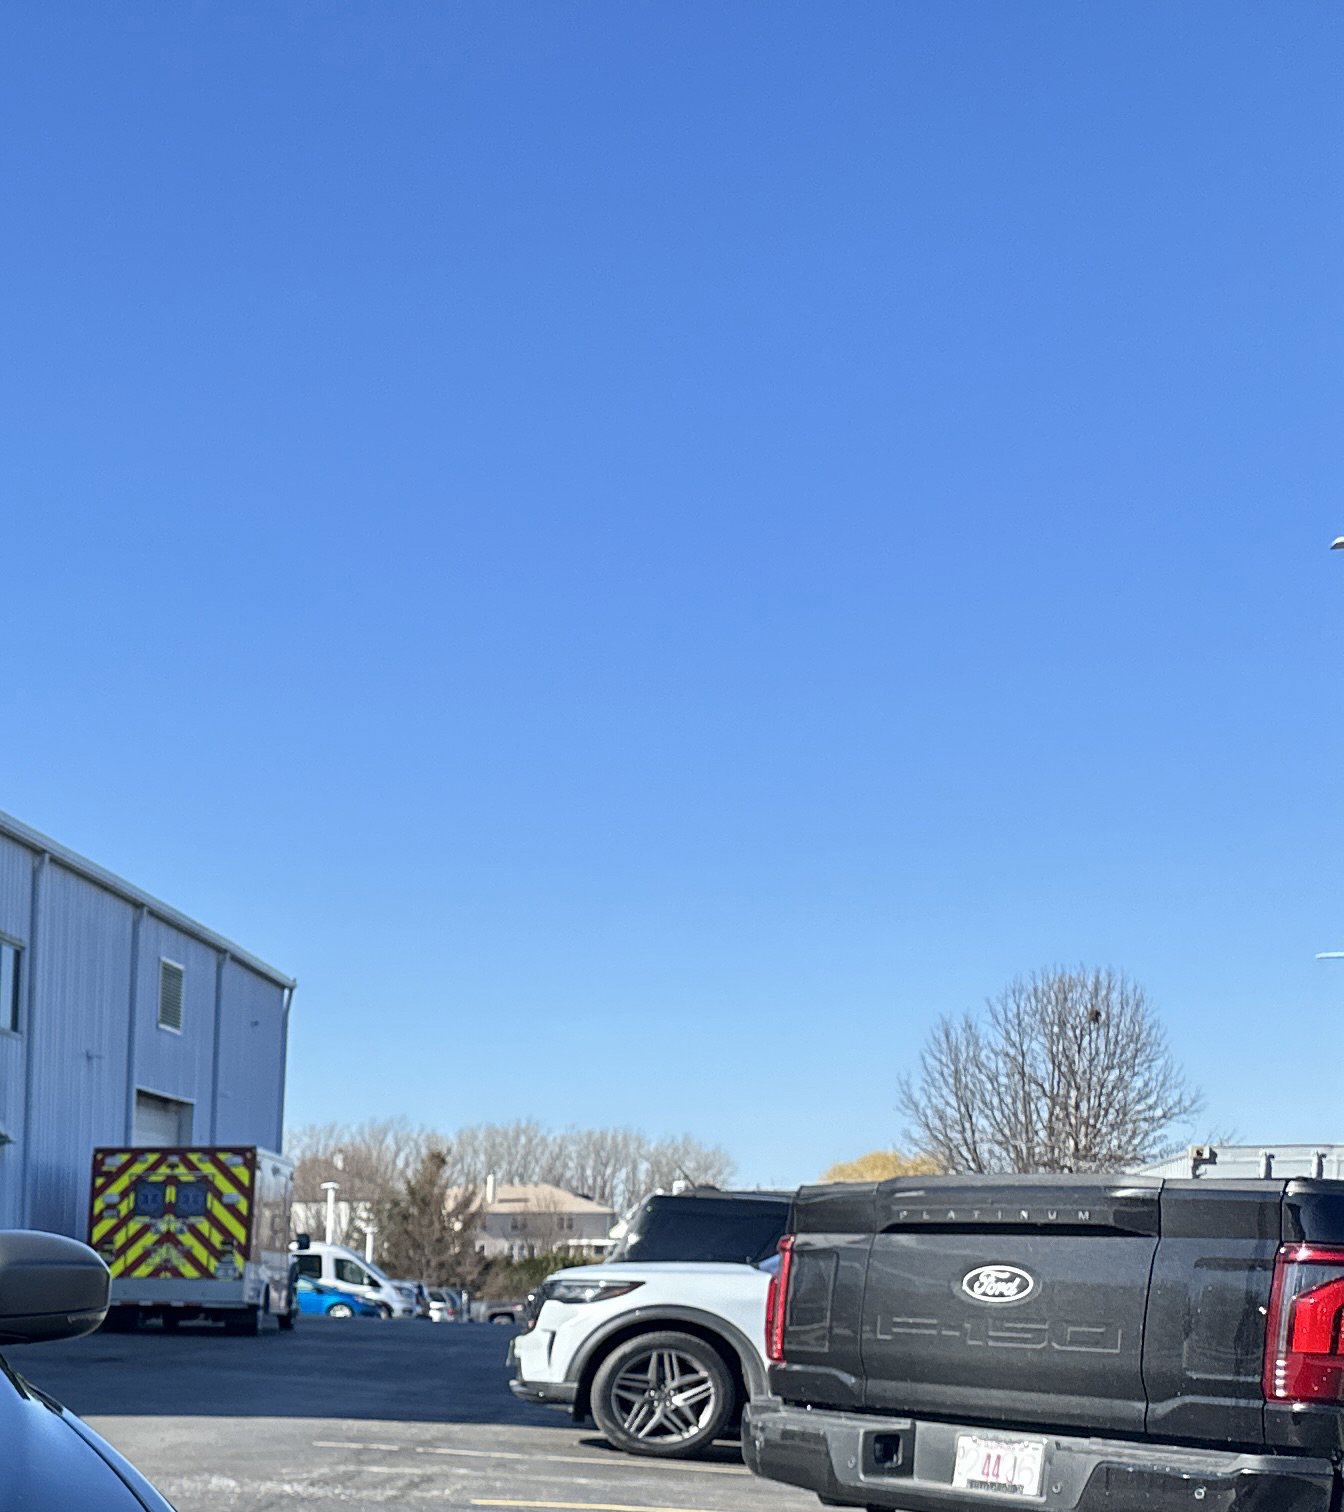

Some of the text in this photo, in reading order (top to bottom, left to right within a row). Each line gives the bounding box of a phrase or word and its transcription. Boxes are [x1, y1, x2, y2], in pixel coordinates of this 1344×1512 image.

[899, 1209, 1091, 1222] PLATINUM
[973, 1269, 1023, 1297] Ford
[876, 1314, 1122, 1354] F-150
